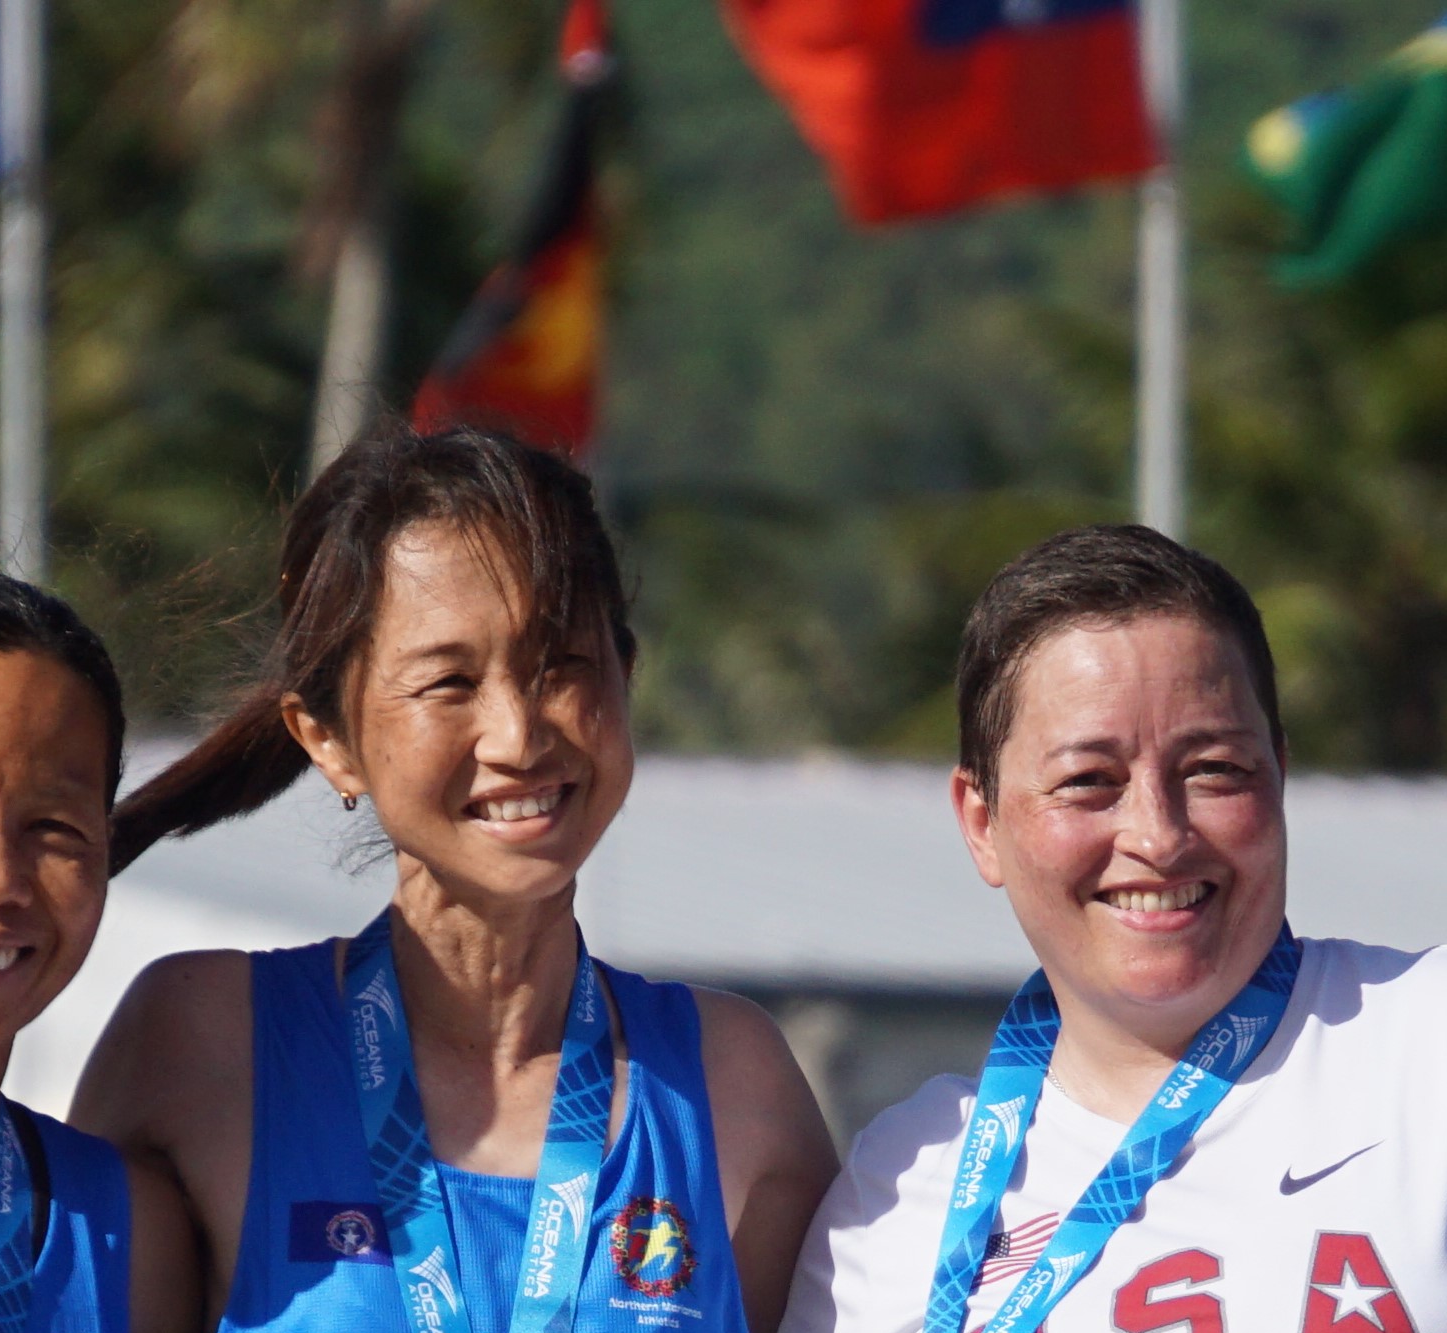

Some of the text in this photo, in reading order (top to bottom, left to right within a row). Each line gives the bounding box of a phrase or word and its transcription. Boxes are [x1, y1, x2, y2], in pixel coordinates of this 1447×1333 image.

[360, 1003, 386, 1088] OCEANIA
[1165, 1028, 1233, 1109] OCEANIA
[961, 1118, 1000, 1209] OCEANIA
[533, 1199, 564, 1299] OCEANIA
[609, 1297, 659, 1312] Northern
